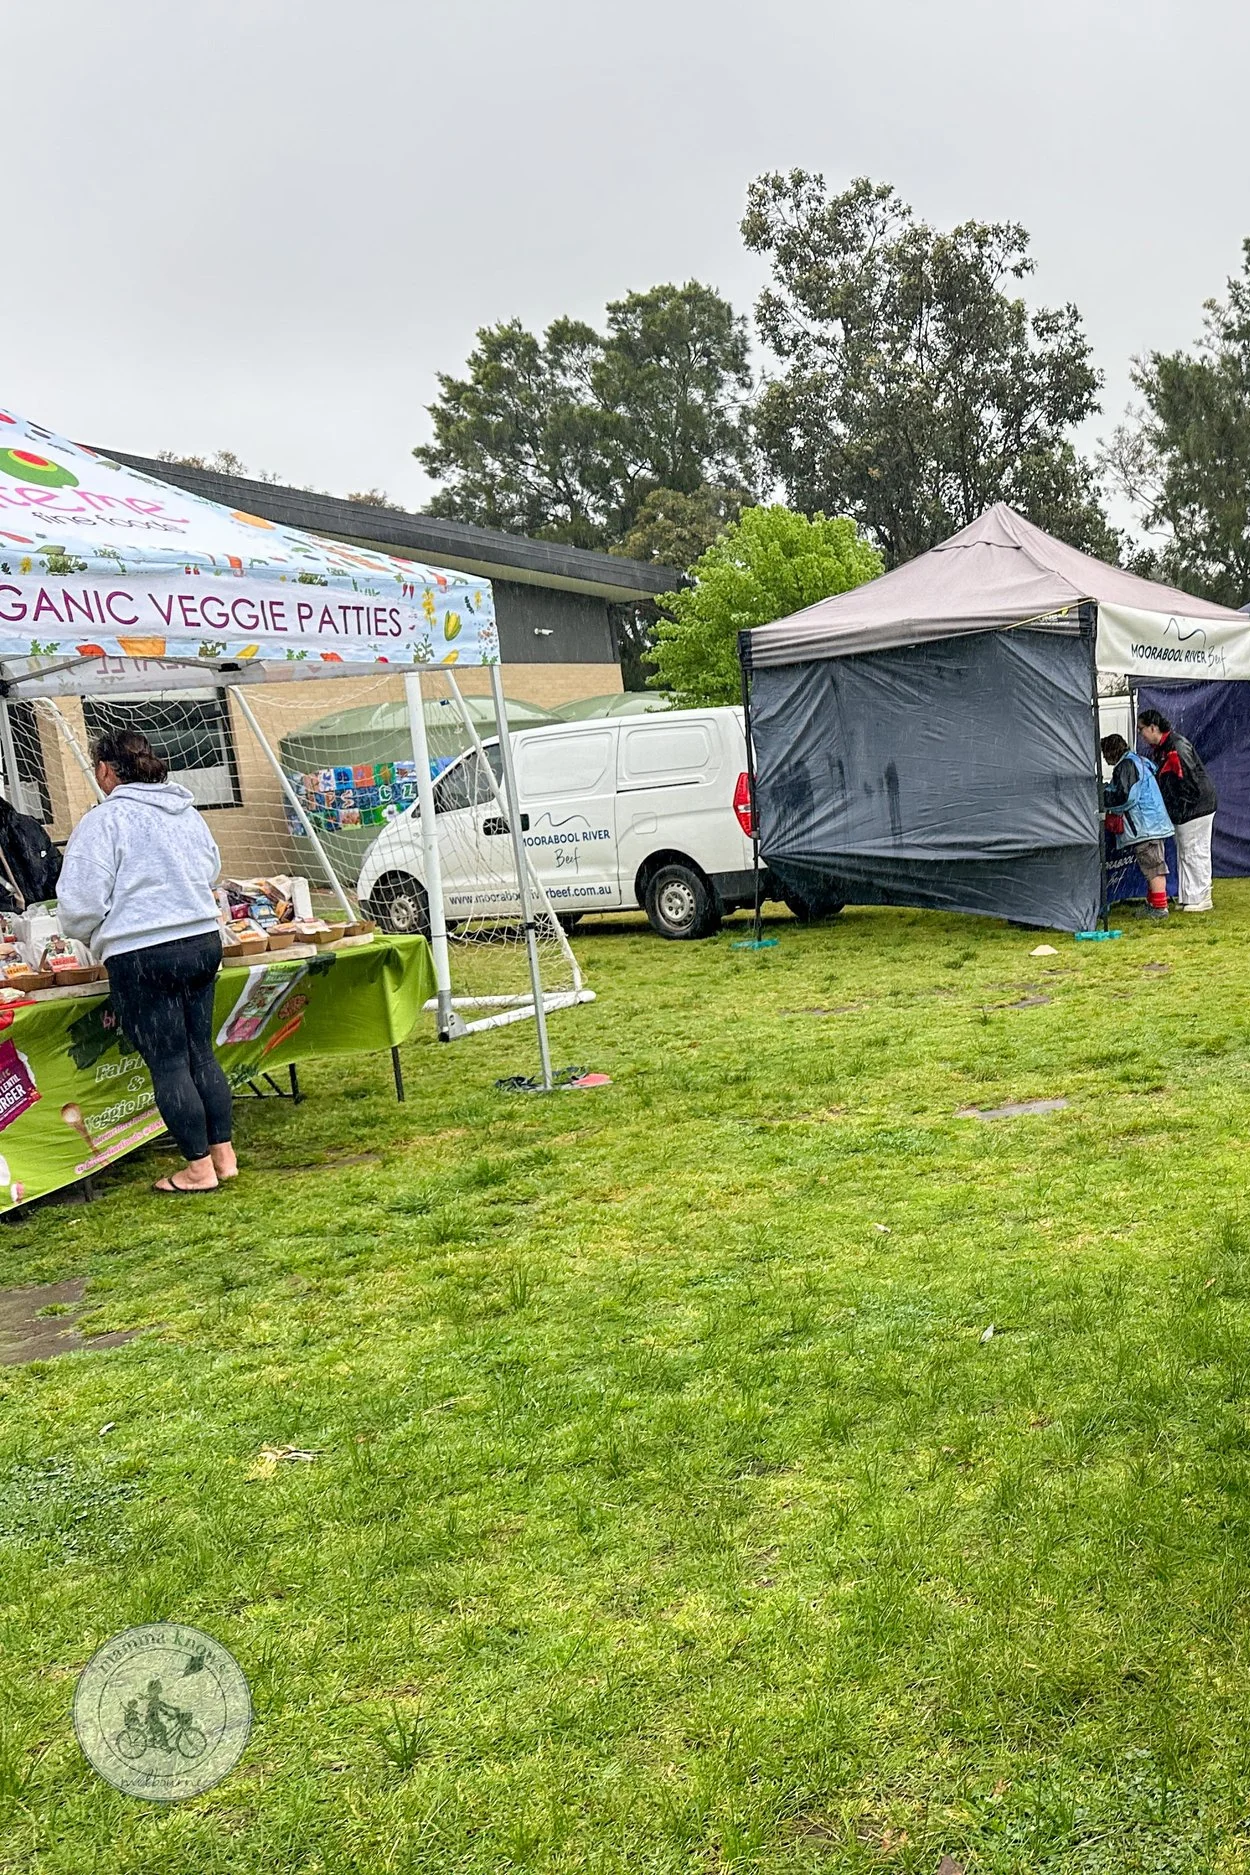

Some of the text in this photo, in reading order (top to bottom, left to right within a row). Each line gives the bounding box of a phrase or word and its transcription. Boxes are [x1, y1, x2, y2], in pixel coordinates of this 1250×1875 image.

[148, 593, 288, 632] VEGGIE
[297, 602, 402, 637] PATTIES
[1131, 643, 1183, 662] MOORABOOL
[1184, 649, 1207, 664] RIVER
[582, 829, 611, 842] RIVER
[554, 847, 581, 874] Beef
[127, 1075, 146, 1092] &
[84, 1098, 136, 1135] Veggie
